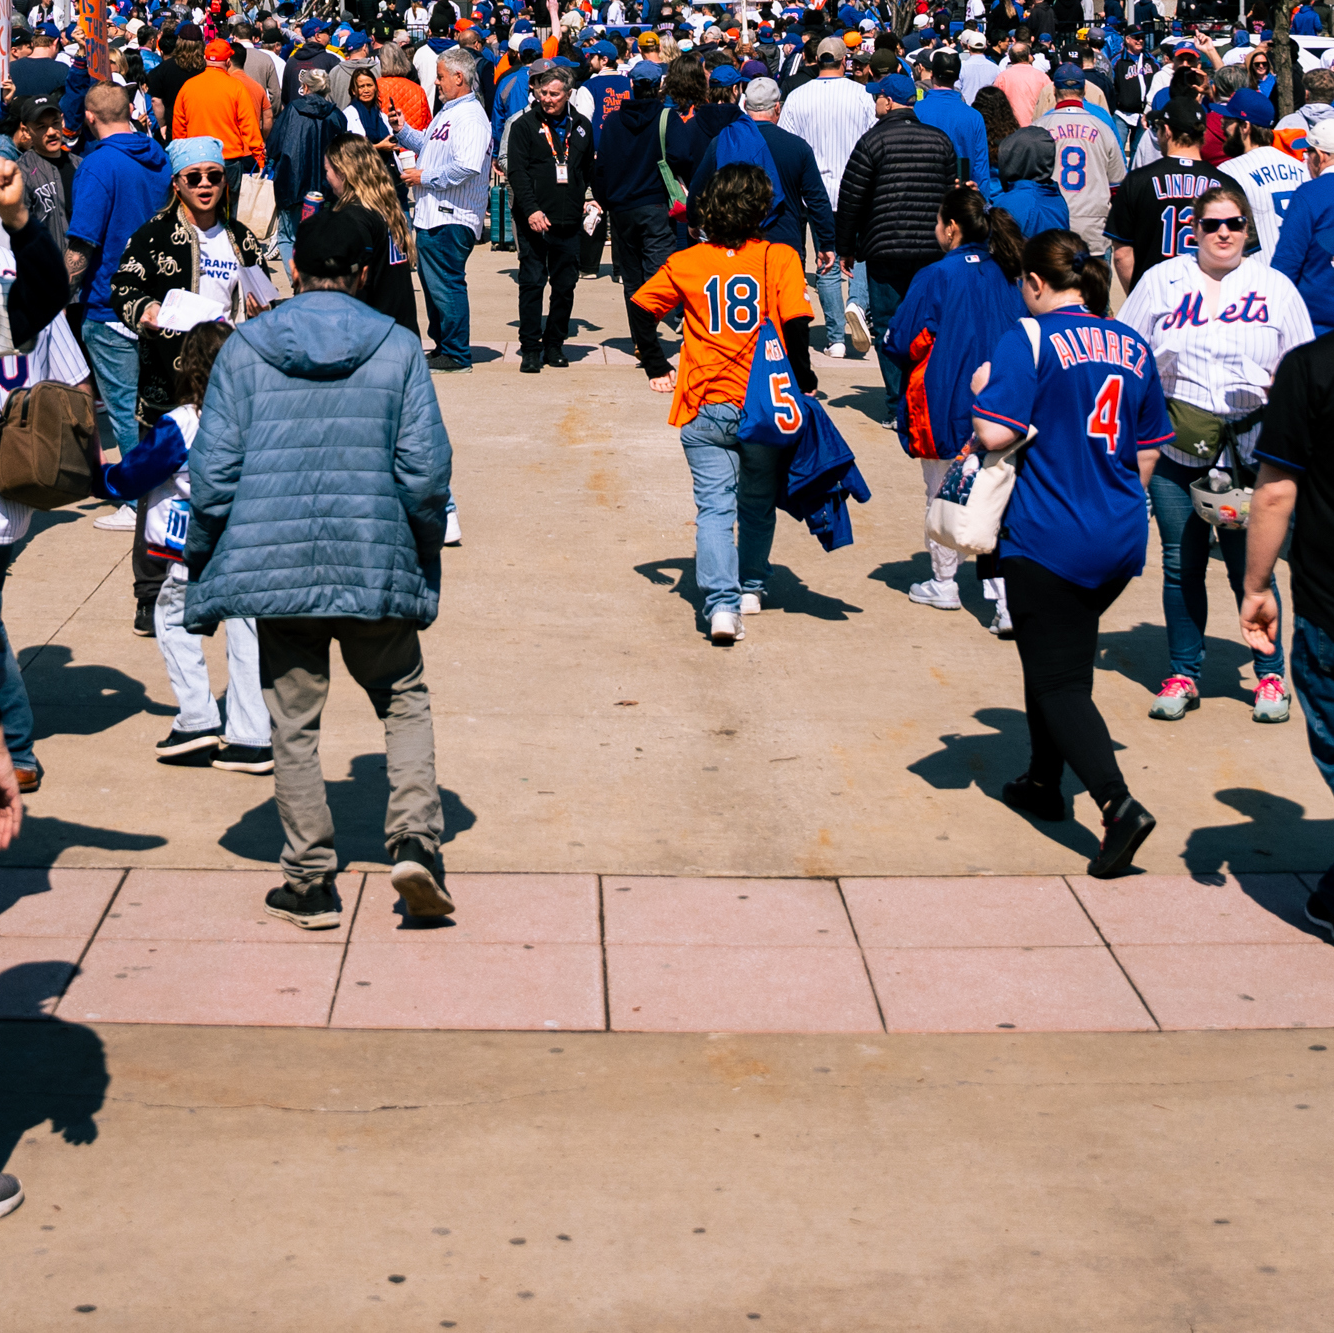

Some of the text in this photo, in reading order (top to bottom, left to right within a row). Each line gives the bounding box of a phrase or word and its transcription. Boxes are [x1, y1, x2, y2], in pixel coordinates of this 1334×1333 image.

[429, 121, 452, 142] ets
[1049, 123, 1099, 144] CARTER
[1059, 144, 1087, 193] 8
[1248, 164, 1304, 187] WRIGHT
[1161, 206, 1201, 257] 12
[207, 270, 230, 281] NYC
[703, 274, 760, 334] 18
[1161, 289, 1269, 331] Mets
[1048, 326, 1148, 380] ALVAREZ
[769, 372, 803, 435] 5
[1086, 374, 1124, 455] 4
